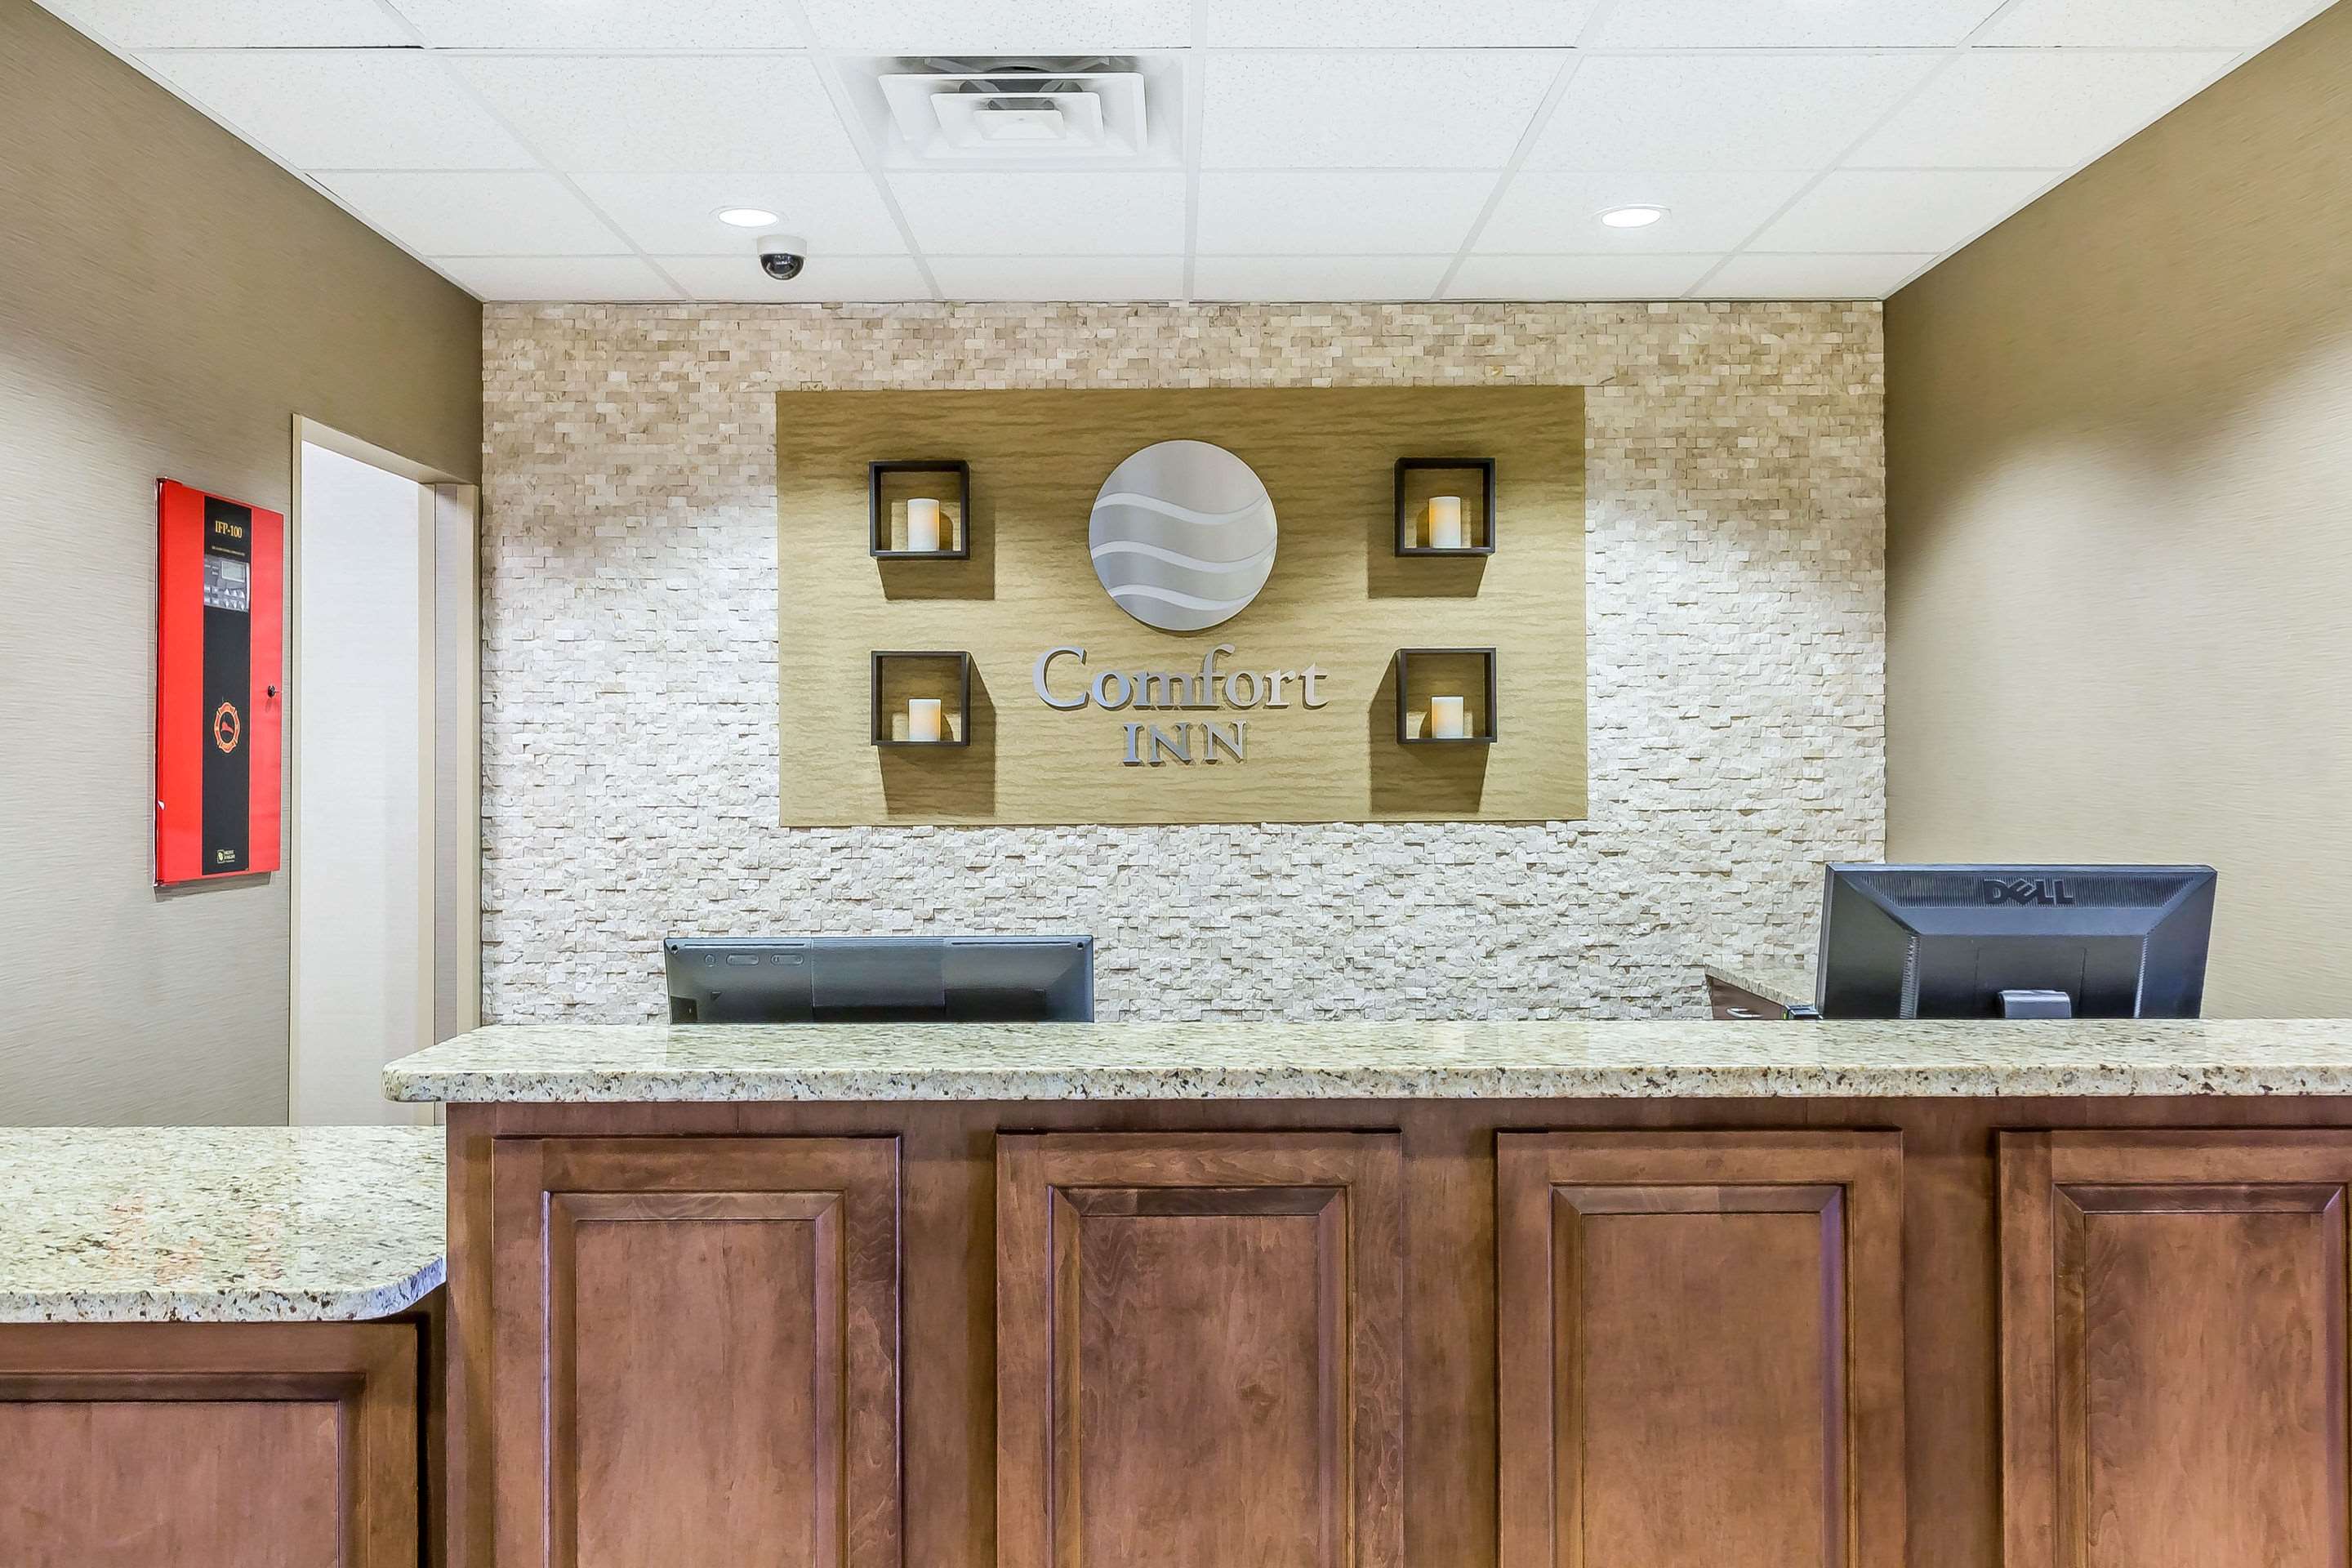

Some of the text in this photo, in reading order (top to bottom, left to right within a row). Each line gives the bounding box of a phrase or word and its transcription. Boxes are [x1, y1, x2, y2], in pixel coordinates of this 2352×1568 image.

[215, 520, 243, 538] IFP-100
[1032, 644, 1330, 710] Comfort
[1121, 719, 1248, 766] INN
[1983, 878, 2074, 904] DELL
